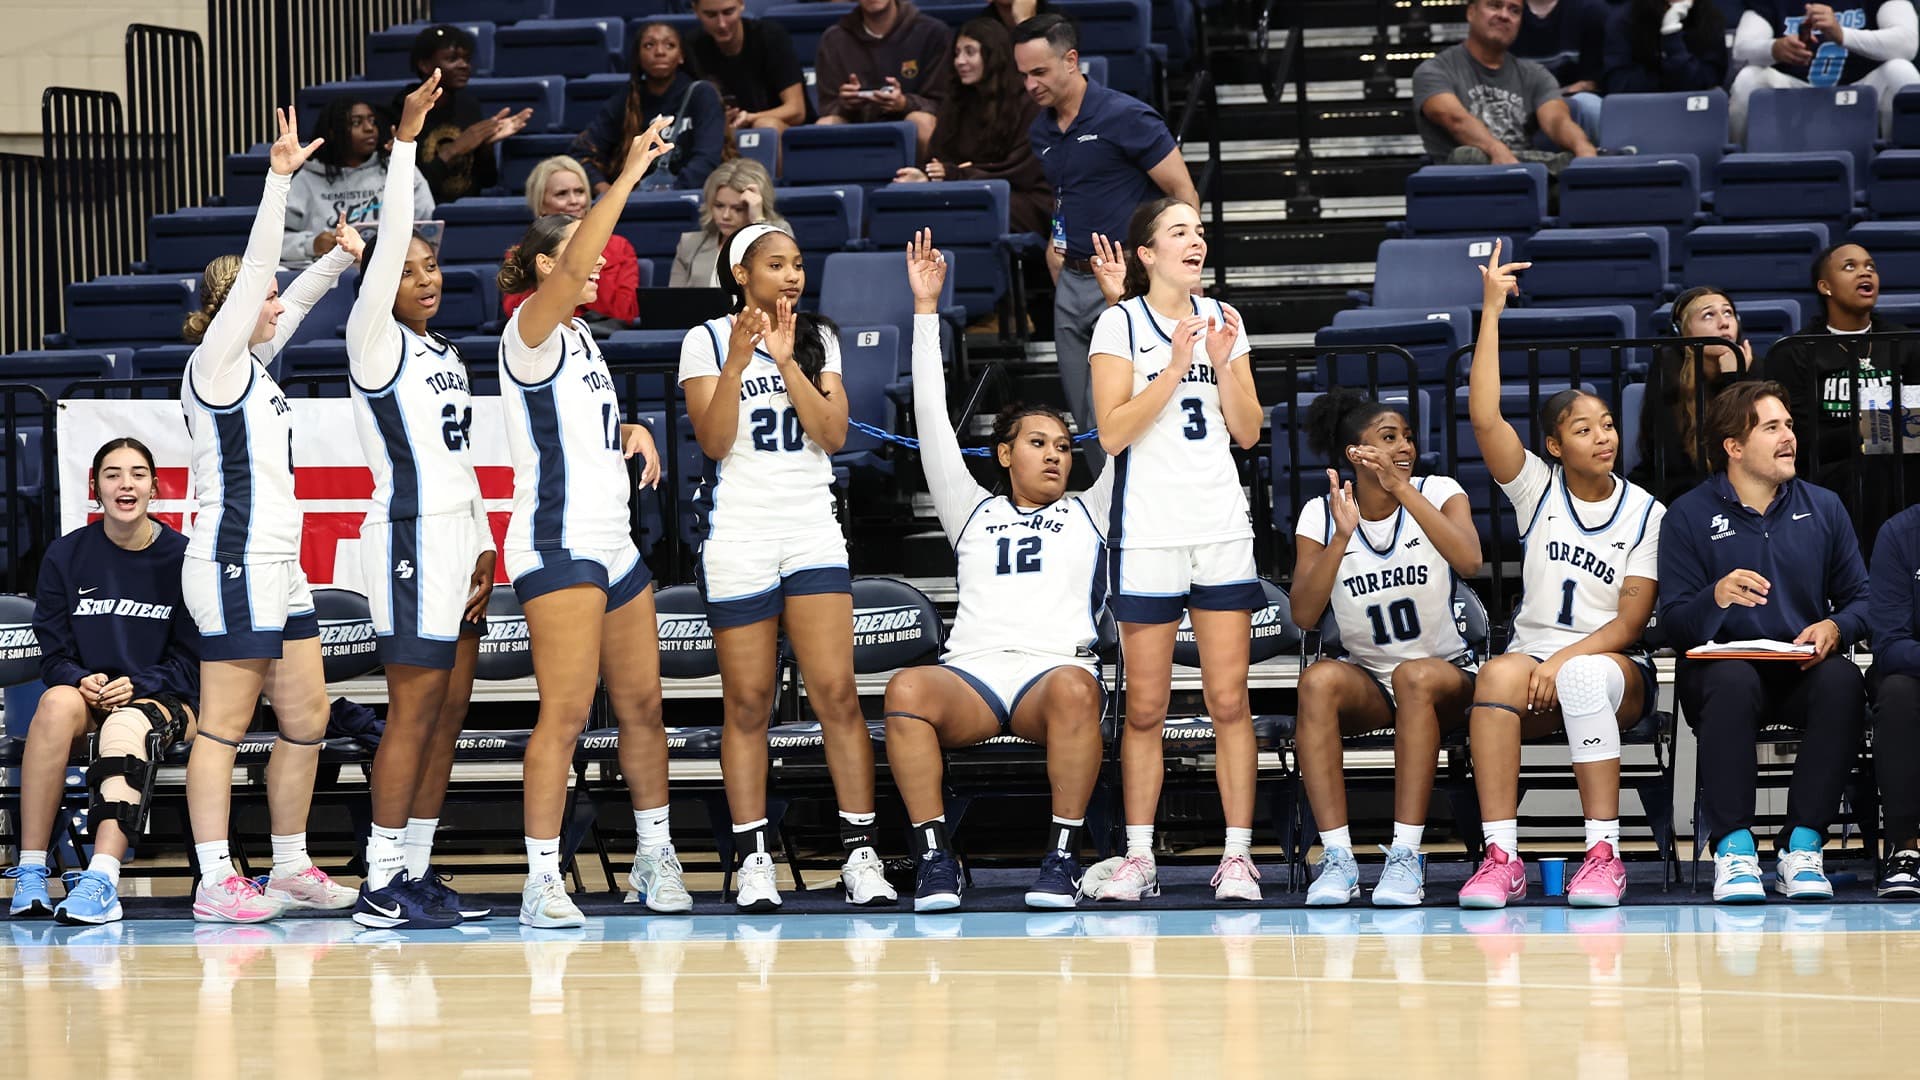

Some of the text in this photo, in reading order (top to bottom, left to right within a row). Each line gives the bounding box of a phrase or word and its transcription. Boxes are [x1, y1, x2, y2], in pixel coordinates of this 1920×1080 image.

[1808, 41, 1848, 87] 0
[865, 333, 872, 345] 6
[1180, 397, 1207, 440] 3
[750, 407, 804, 452] 20
[1710, 513, 1729, 534] SD
[1404, 537, 1420, 549] WCC
[996, 535, 1043, 575] 12
[1546, 540, 1616, 585] OREROS
[1342, 564, 1429, 597] TOREROS
[72, 598, 173, 620] SAN DIEGO
[1556, 577, 1577, 627] 1
[1254, 624, 1282, 638] DIEGO
[1365, 597, 1422, 646] 10
[682, 640, 695, 650] OF
[695, 639, 713, 650] SAN
[865, 634, 877, 645] OF
[877, 631, 895, 644] SAN
[896, 627, 922, 642] DIEGO
[7, 648, 24, 660] SAN
[25, 645, 43, 658] DIEG
[321, 641, 377, 657] OF SAN DIEGO
[499, 641, 511, 653] OF
[511, 640, 529, 652] SAN
[454, 738, 507, 750] ros.com
[769, 734, 825, 748] USDTore
